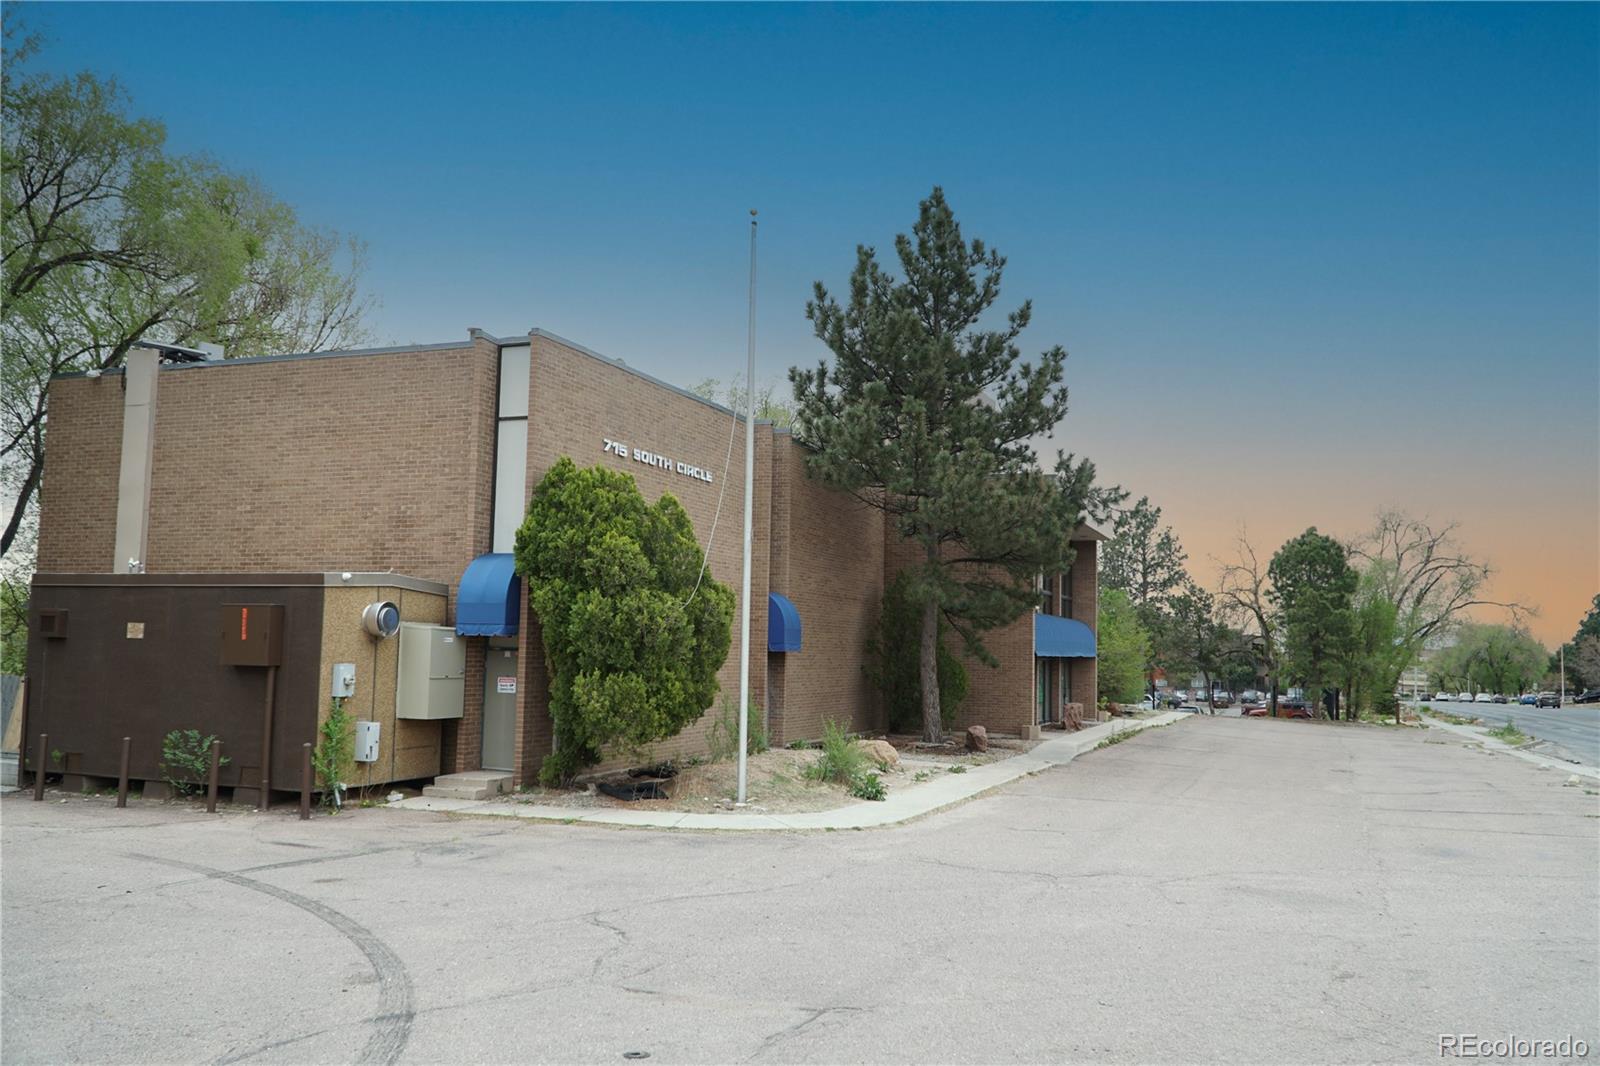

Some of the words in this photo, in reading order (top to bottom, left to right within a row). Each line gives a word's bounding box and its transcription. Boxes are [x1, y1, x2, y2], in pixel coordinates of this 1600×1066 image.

[603, 438, 628, 457] 715
[633, 448, 672, 470] SOUTH
[676, 461, 713, 483] CIRCLE
